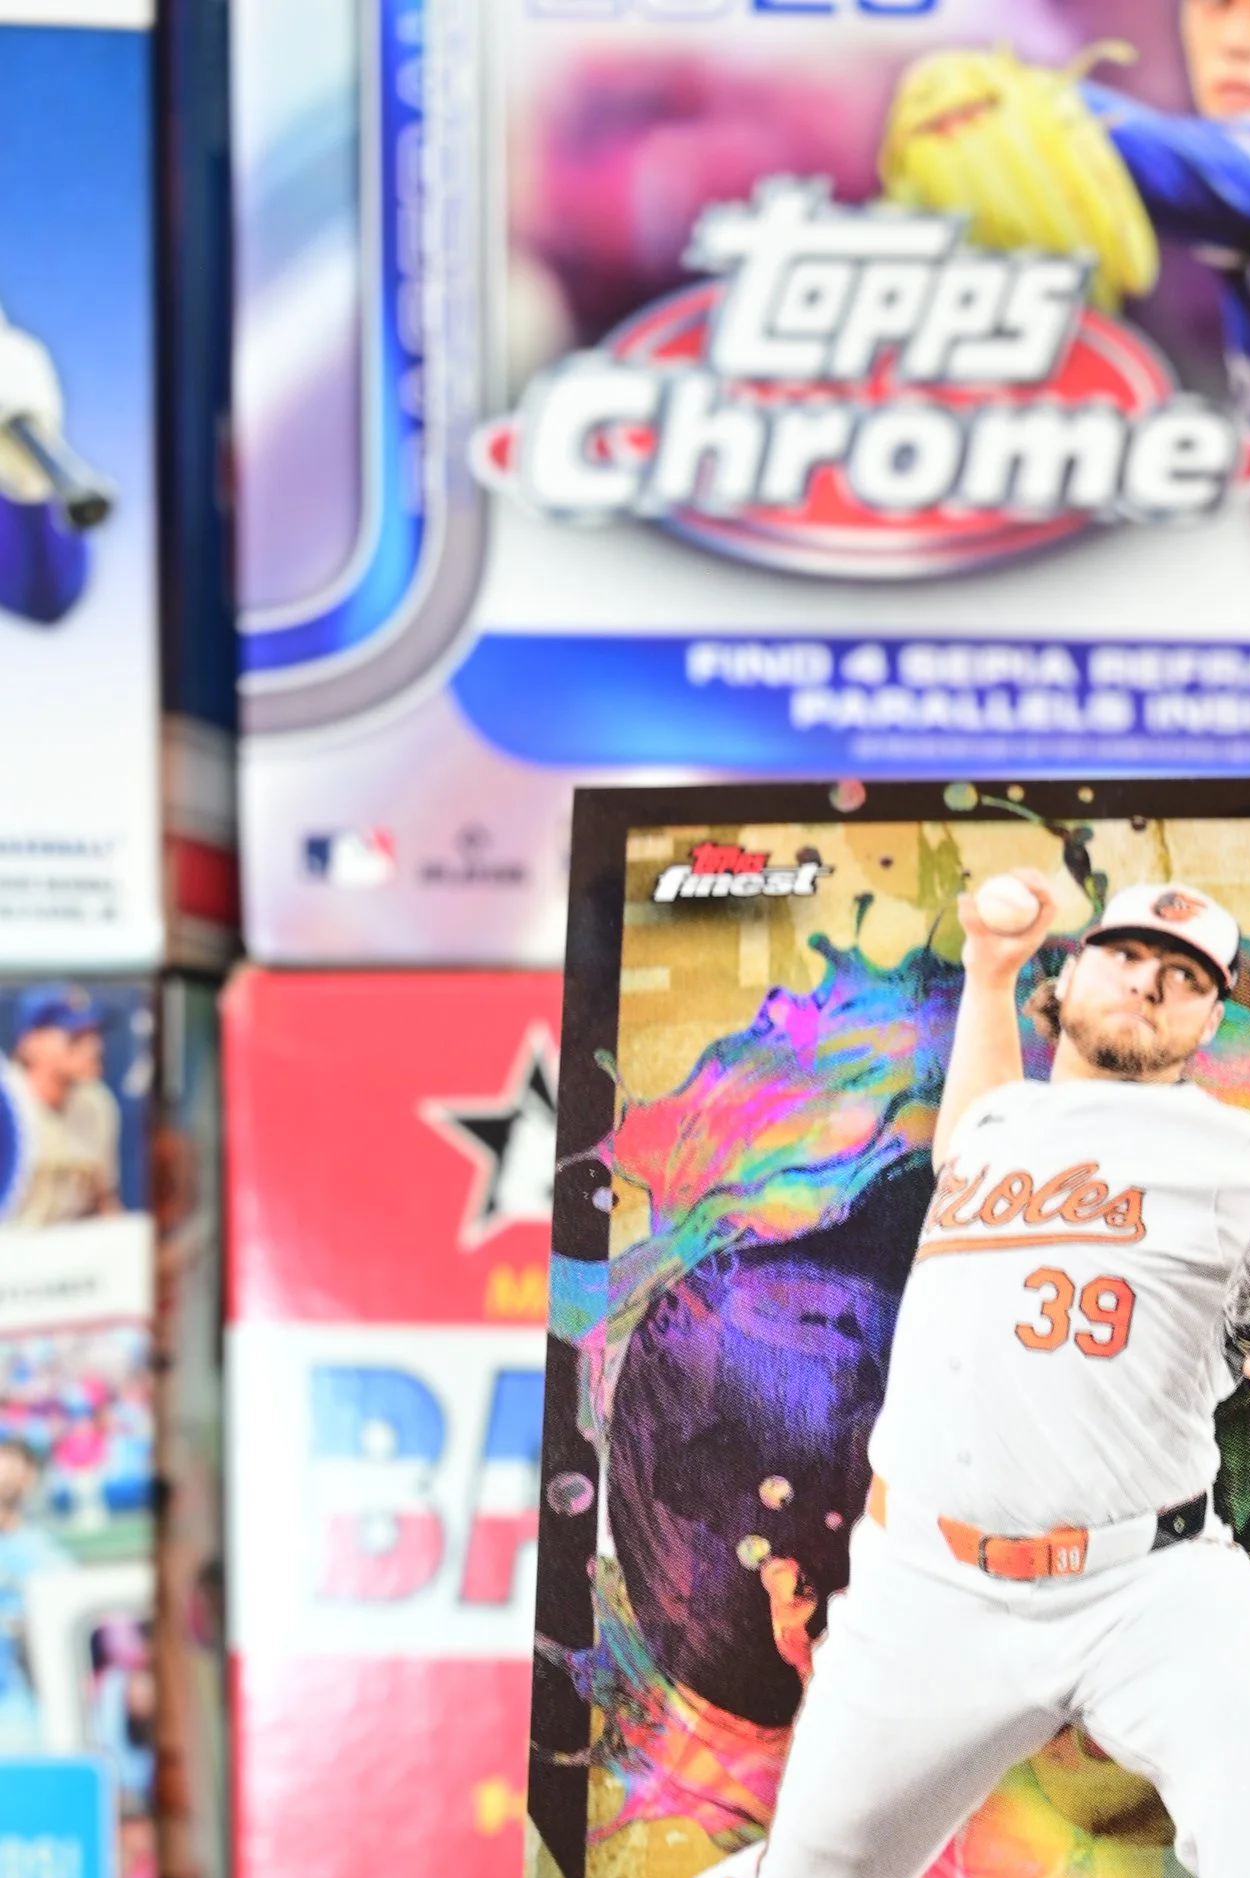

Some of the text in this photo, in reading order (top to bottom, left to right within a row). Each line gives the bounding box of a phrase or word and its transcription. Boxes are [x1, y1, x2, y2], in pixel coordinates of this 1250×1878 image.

[526, 365, 1236, 508] Chrome
[686, 642, 834, 688] FIND
[840, 643, 889, 687] 4
[898, 644, 1081, 690] SEPIA
[790, 688, 1135, 733] PARALLELS
[1014, 1266, 1136, 1359] 39
